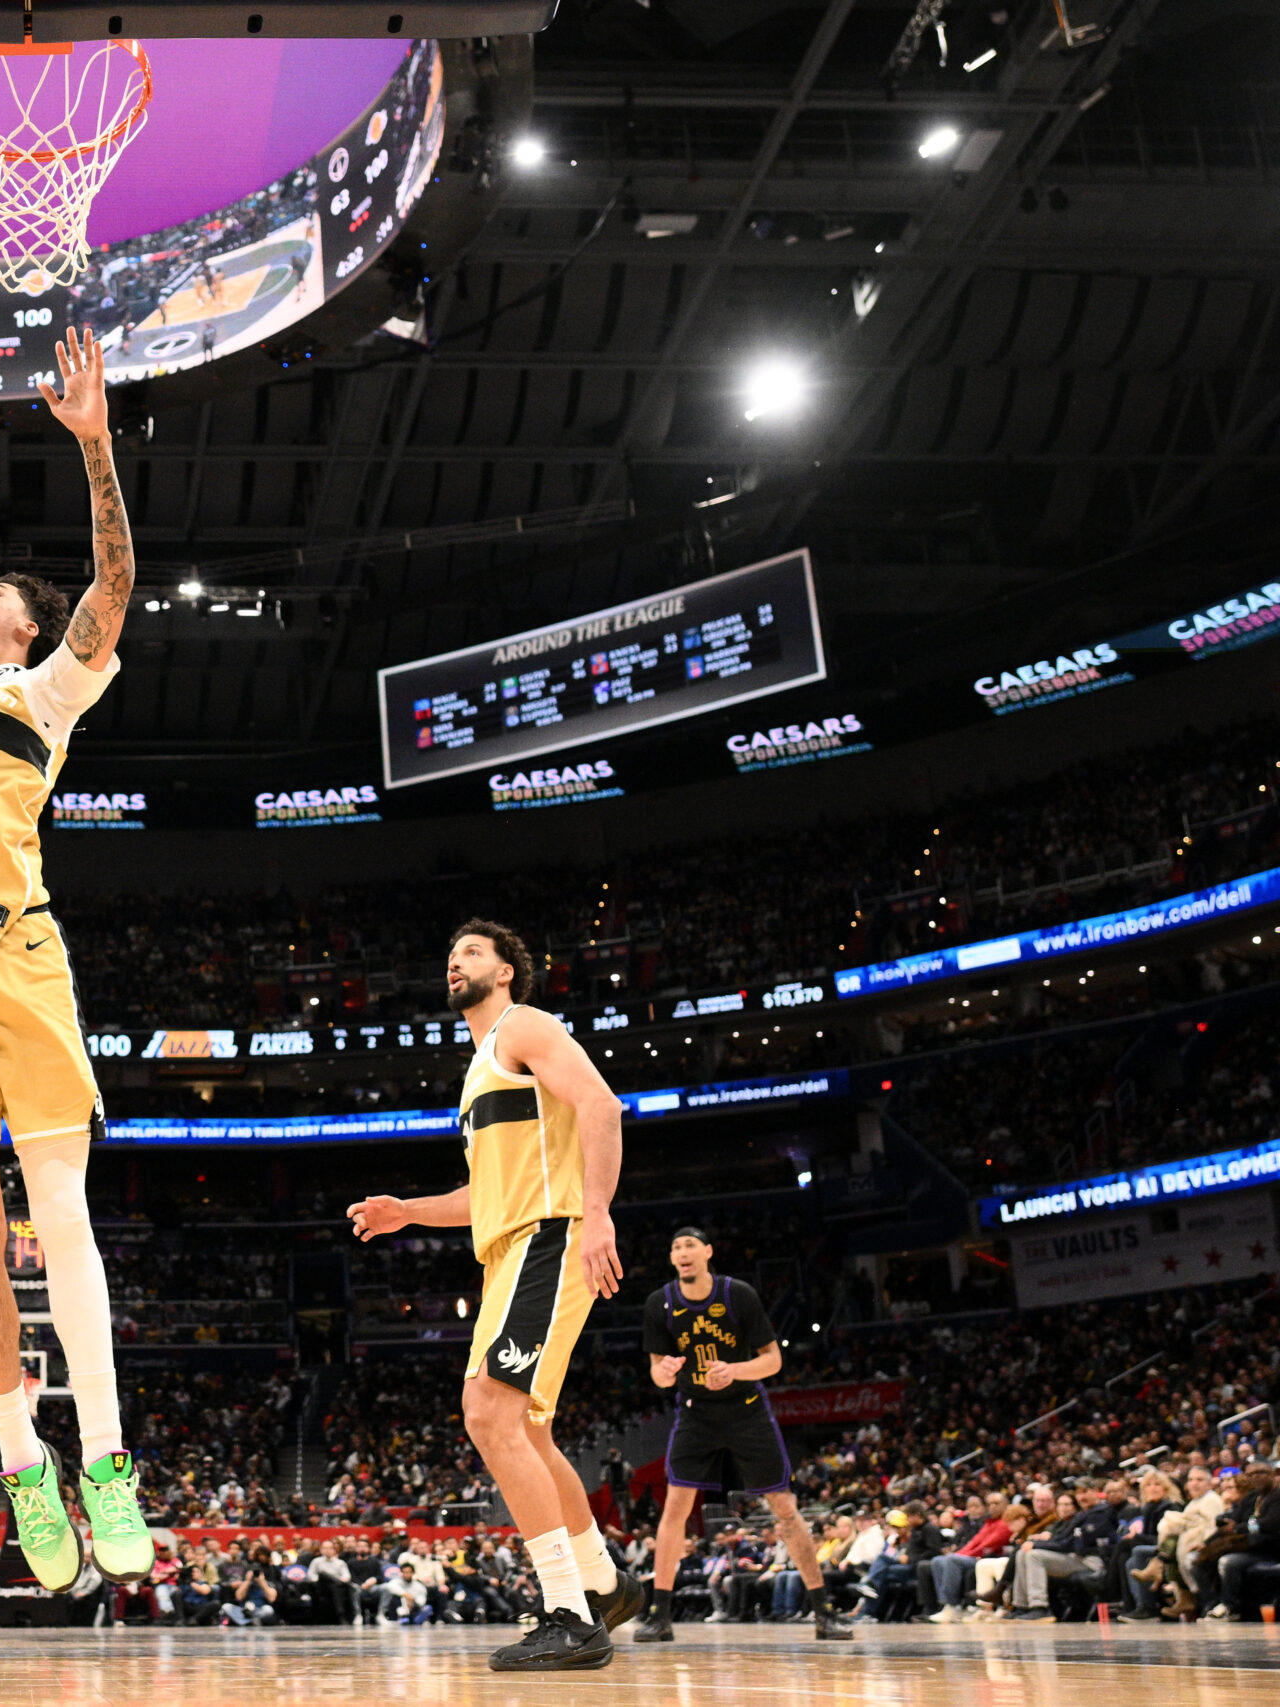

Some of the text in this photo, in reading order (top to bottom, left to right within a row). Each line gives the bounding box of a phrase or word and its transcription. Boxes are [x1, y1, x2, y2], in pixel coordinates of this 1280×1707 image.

[330, 188, 350, 216] 63
[13, 308, 53, 328] 100
[493, 596, 685, 666] AROUND THE LEAGUE
[974, 643, 1117, 696] CAESARS
[984, 666, 1102, 708] SPORTSBOOK
[727, 714, 862, 752] CAESARS
[733, 735, 842, 765] SPORTSBOOK
[489, 760, 613, 791] CAESARS
[255, 785, 378, 809] CAESARS
[492, 780, 597, 802] SPORTSBOOK
[256, 803, 357, 820] SPORTSBOOK
[1033, 885, 1251, 954] www.ironbow.com/dell
[837, 975, 861, 993] OR
[87, 1034, 131, 1057] 100
[110, 1126, 188, 1138] DEVELOPMENT
[191, 1126, 227, 1138] TODAY
[228, 1127, 253, 1138] AND
[253, 1127, 284, 1138] TURN
[284, 1125, 320, 1137] EVERY
[396, 1119, 406, 1131] A
[1000, 1192, 1077, 1223] LAUNCH
[1079, 1181, 1132, 1208] YOUR
[1136, 1176, 1158, 1199] AI
[15, 1238, 43, 1268] 14
[1052, 1225, 1139, 1258] VAULTS
[694, 1343, 718, 1372] 11
